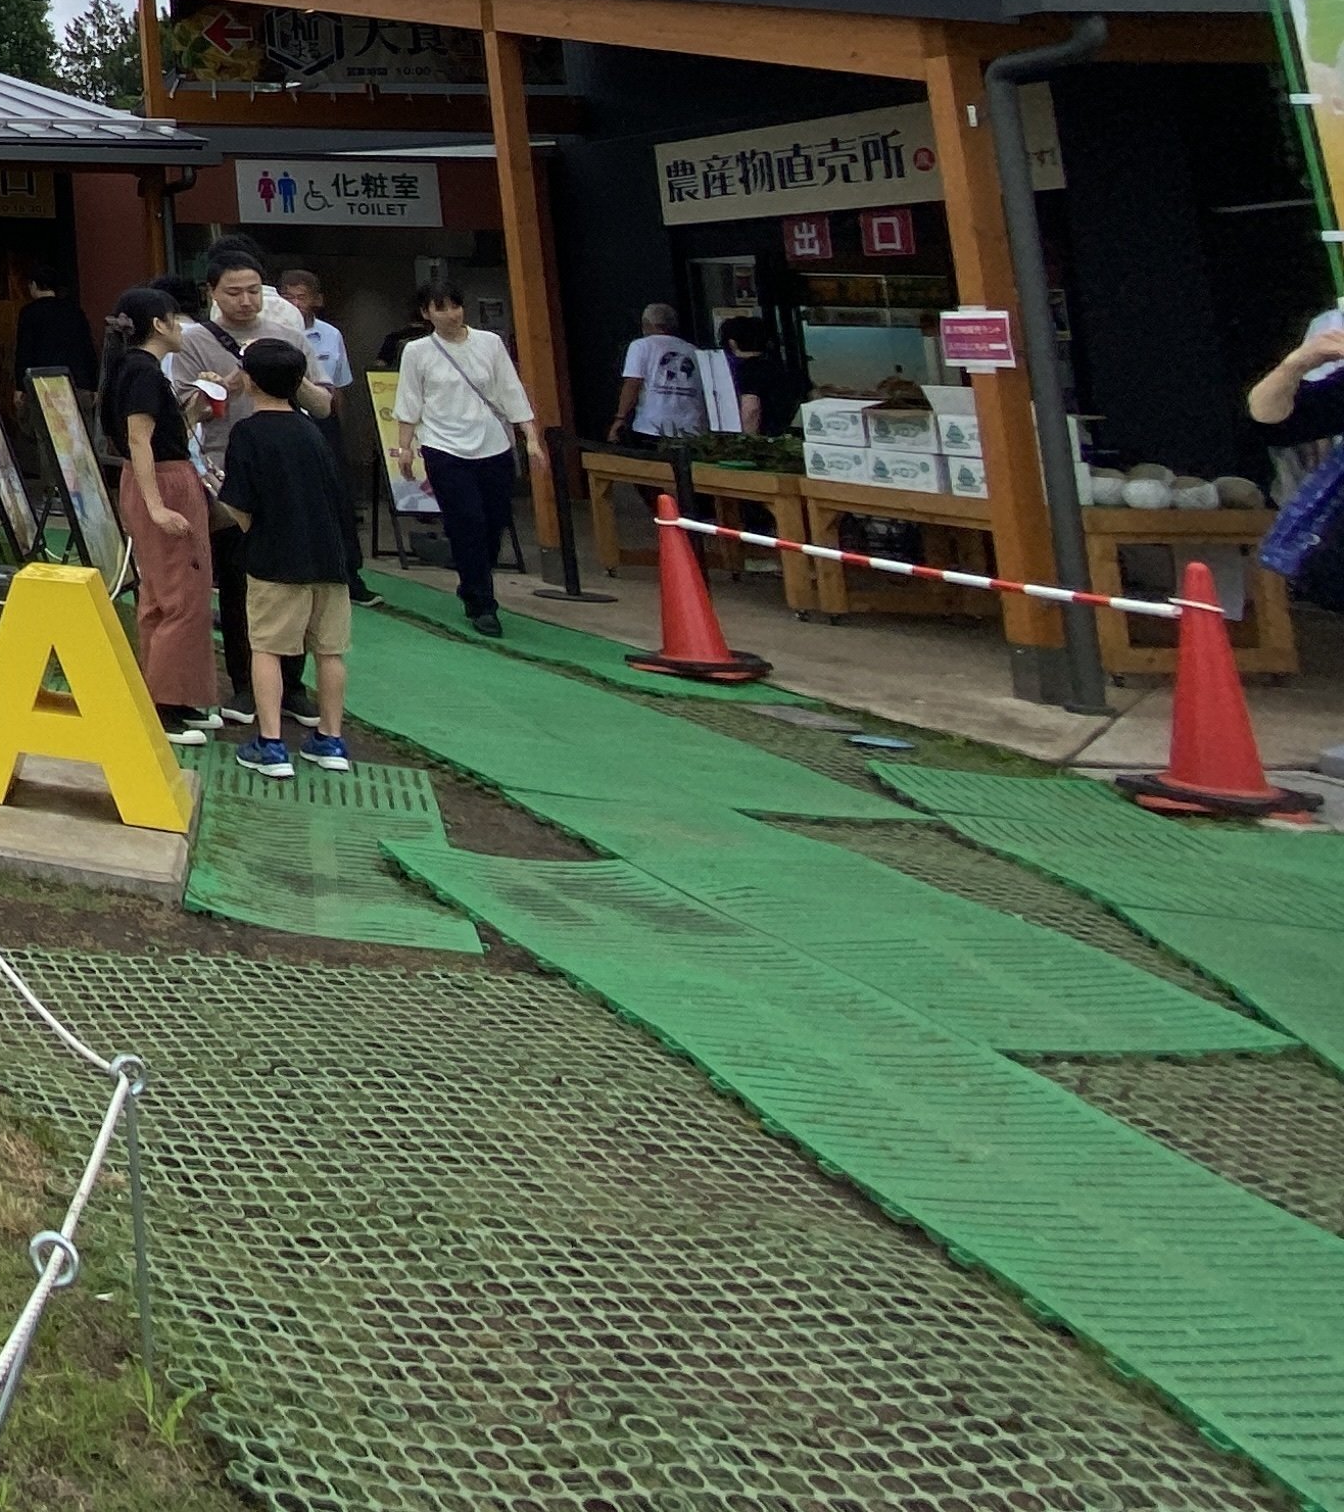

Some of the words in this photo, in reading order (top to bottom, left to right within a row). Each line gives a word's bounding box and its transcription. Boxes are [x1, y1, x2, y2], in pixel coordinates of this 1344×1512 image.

[666, 128, 907, 204] 農産物直売所
[331, 172, 421, 201] 化粧室
[346, 202, 409, 217] TOILET
